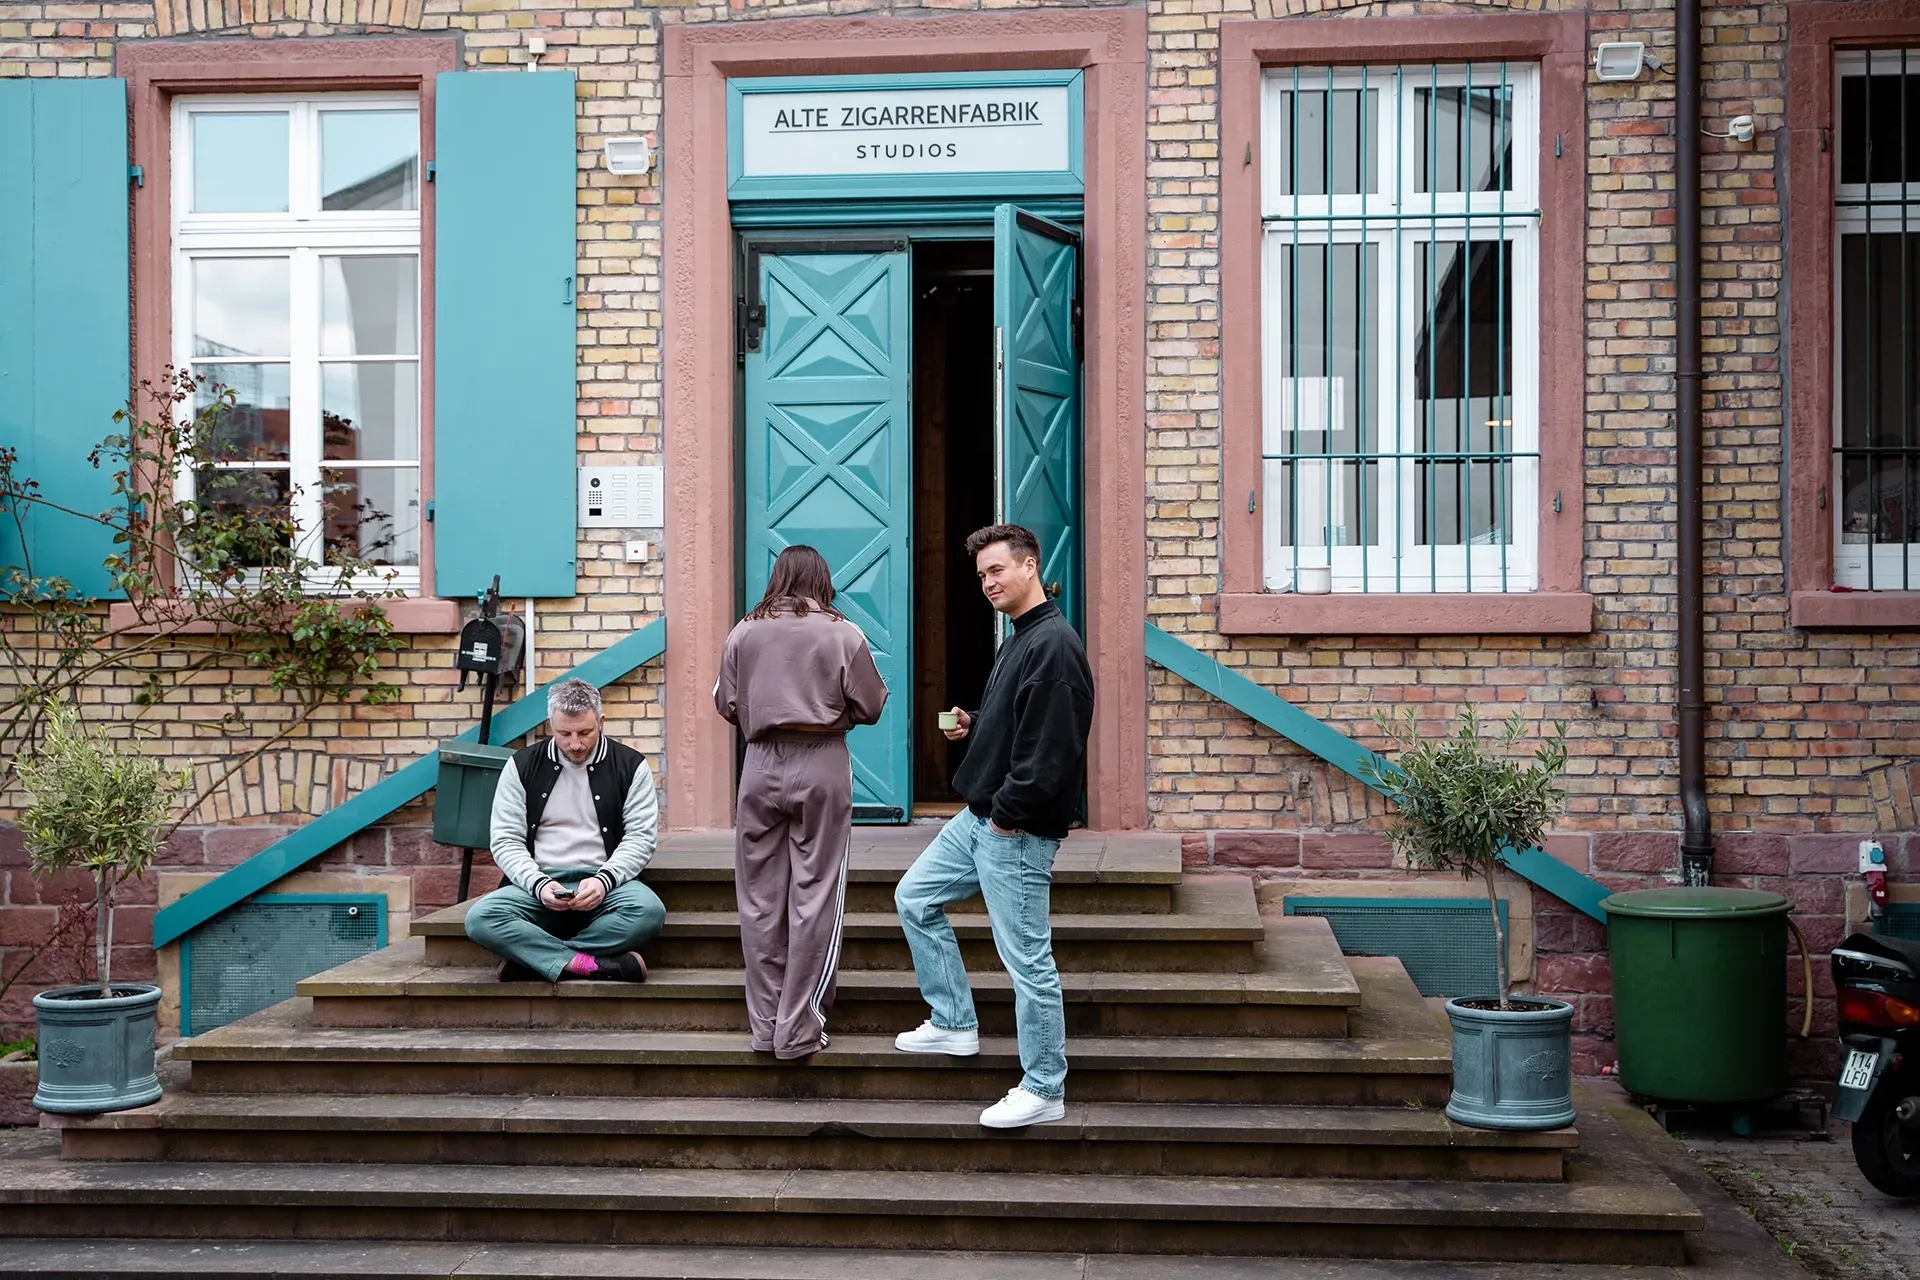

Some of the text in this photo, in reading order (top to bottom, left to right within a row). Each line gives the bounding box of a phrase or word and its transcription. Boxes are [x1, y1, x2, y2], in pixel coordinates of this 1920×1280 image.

[774, 101, 1039, 128] ALTE ZIGARRENFABRIK
[856, 143, 957, 159] STUDIOS
[1851, 1052, 1873, 1070] 114
[1843, 1070, 1868, 1086] LFD
